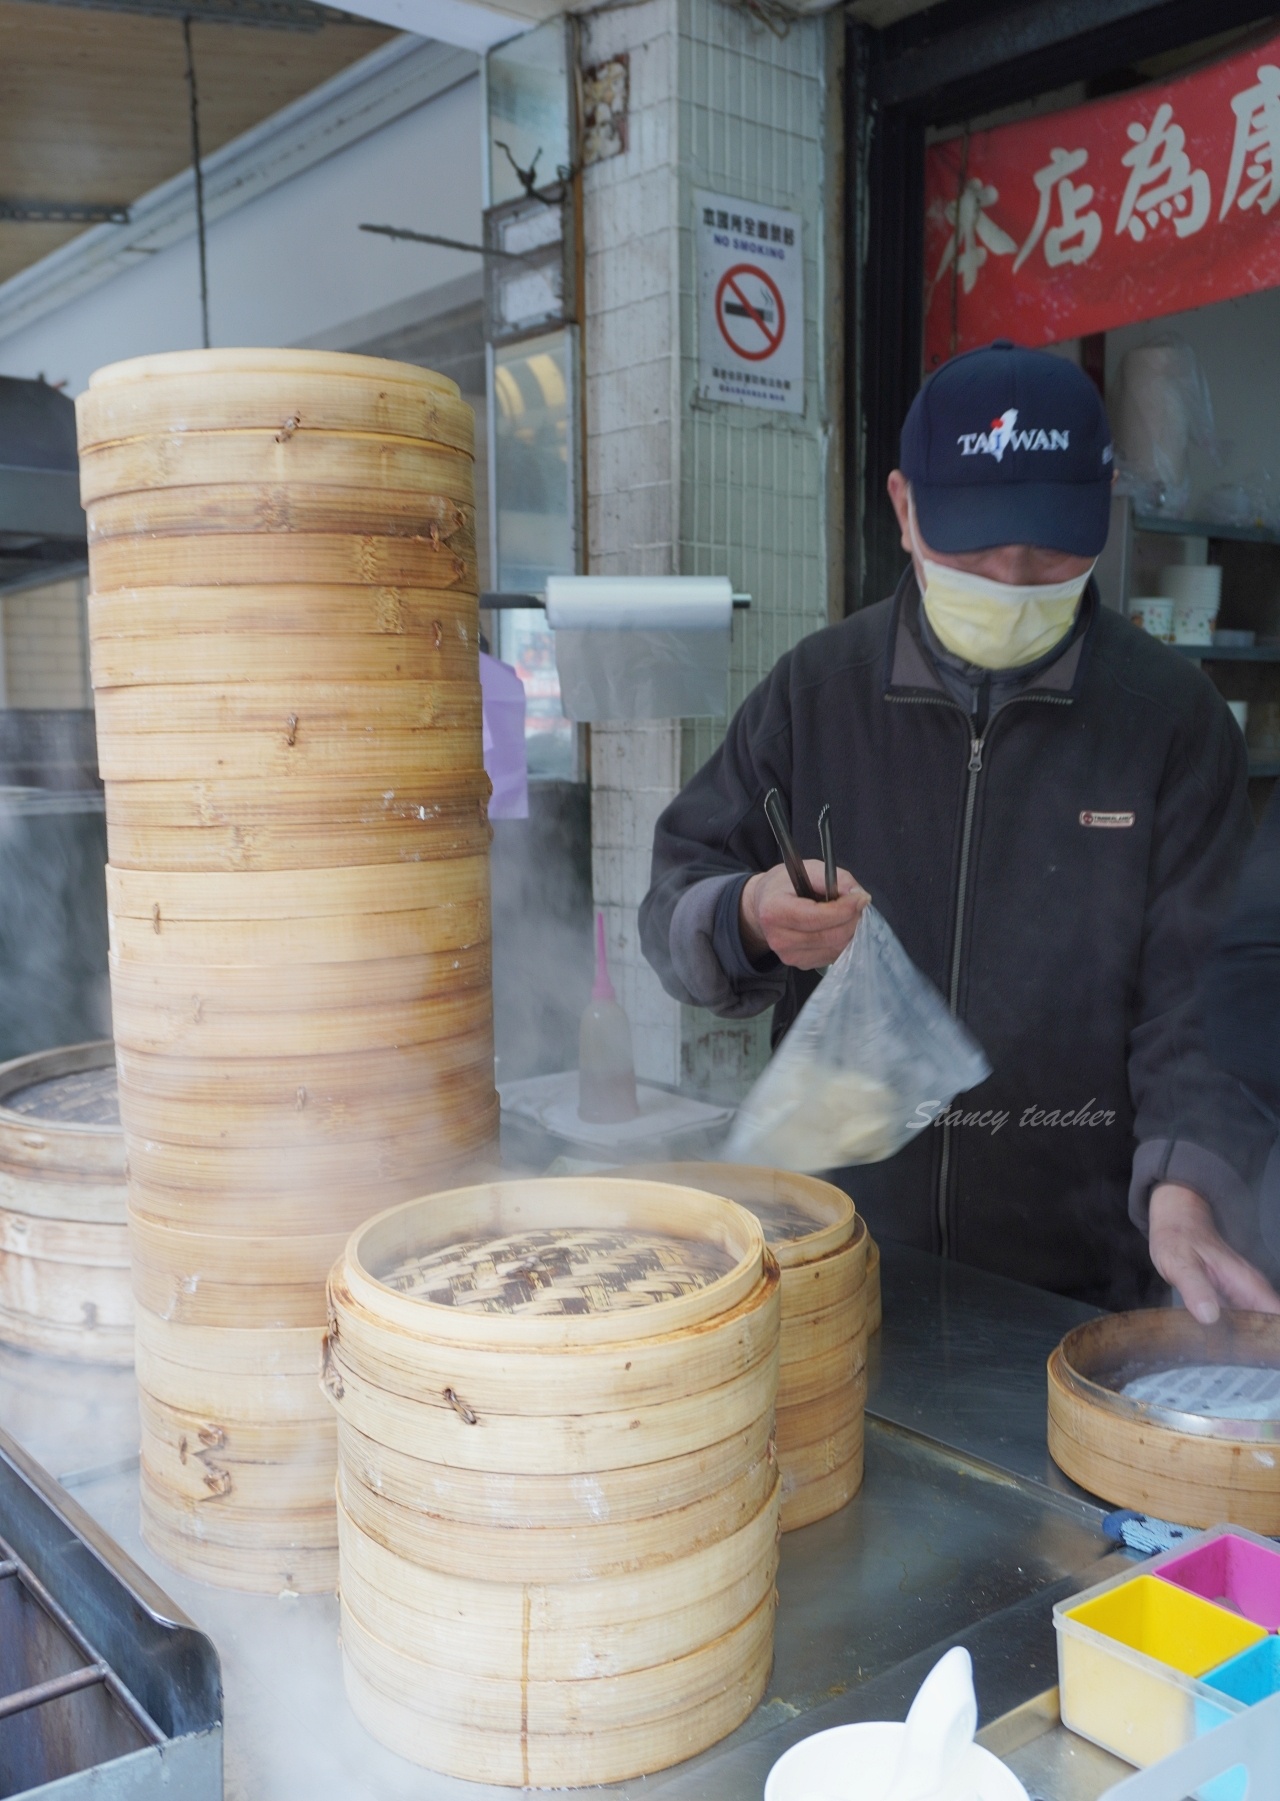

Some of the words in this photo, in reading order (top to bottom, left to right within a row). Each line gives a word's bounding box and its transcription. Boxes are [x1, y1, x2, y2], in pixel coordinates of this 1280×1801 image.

[713, 233, 730, 248] NO
[733, 237, 785, 261] SMOKING
[957, 418, 1070, 457] TAIWAN
